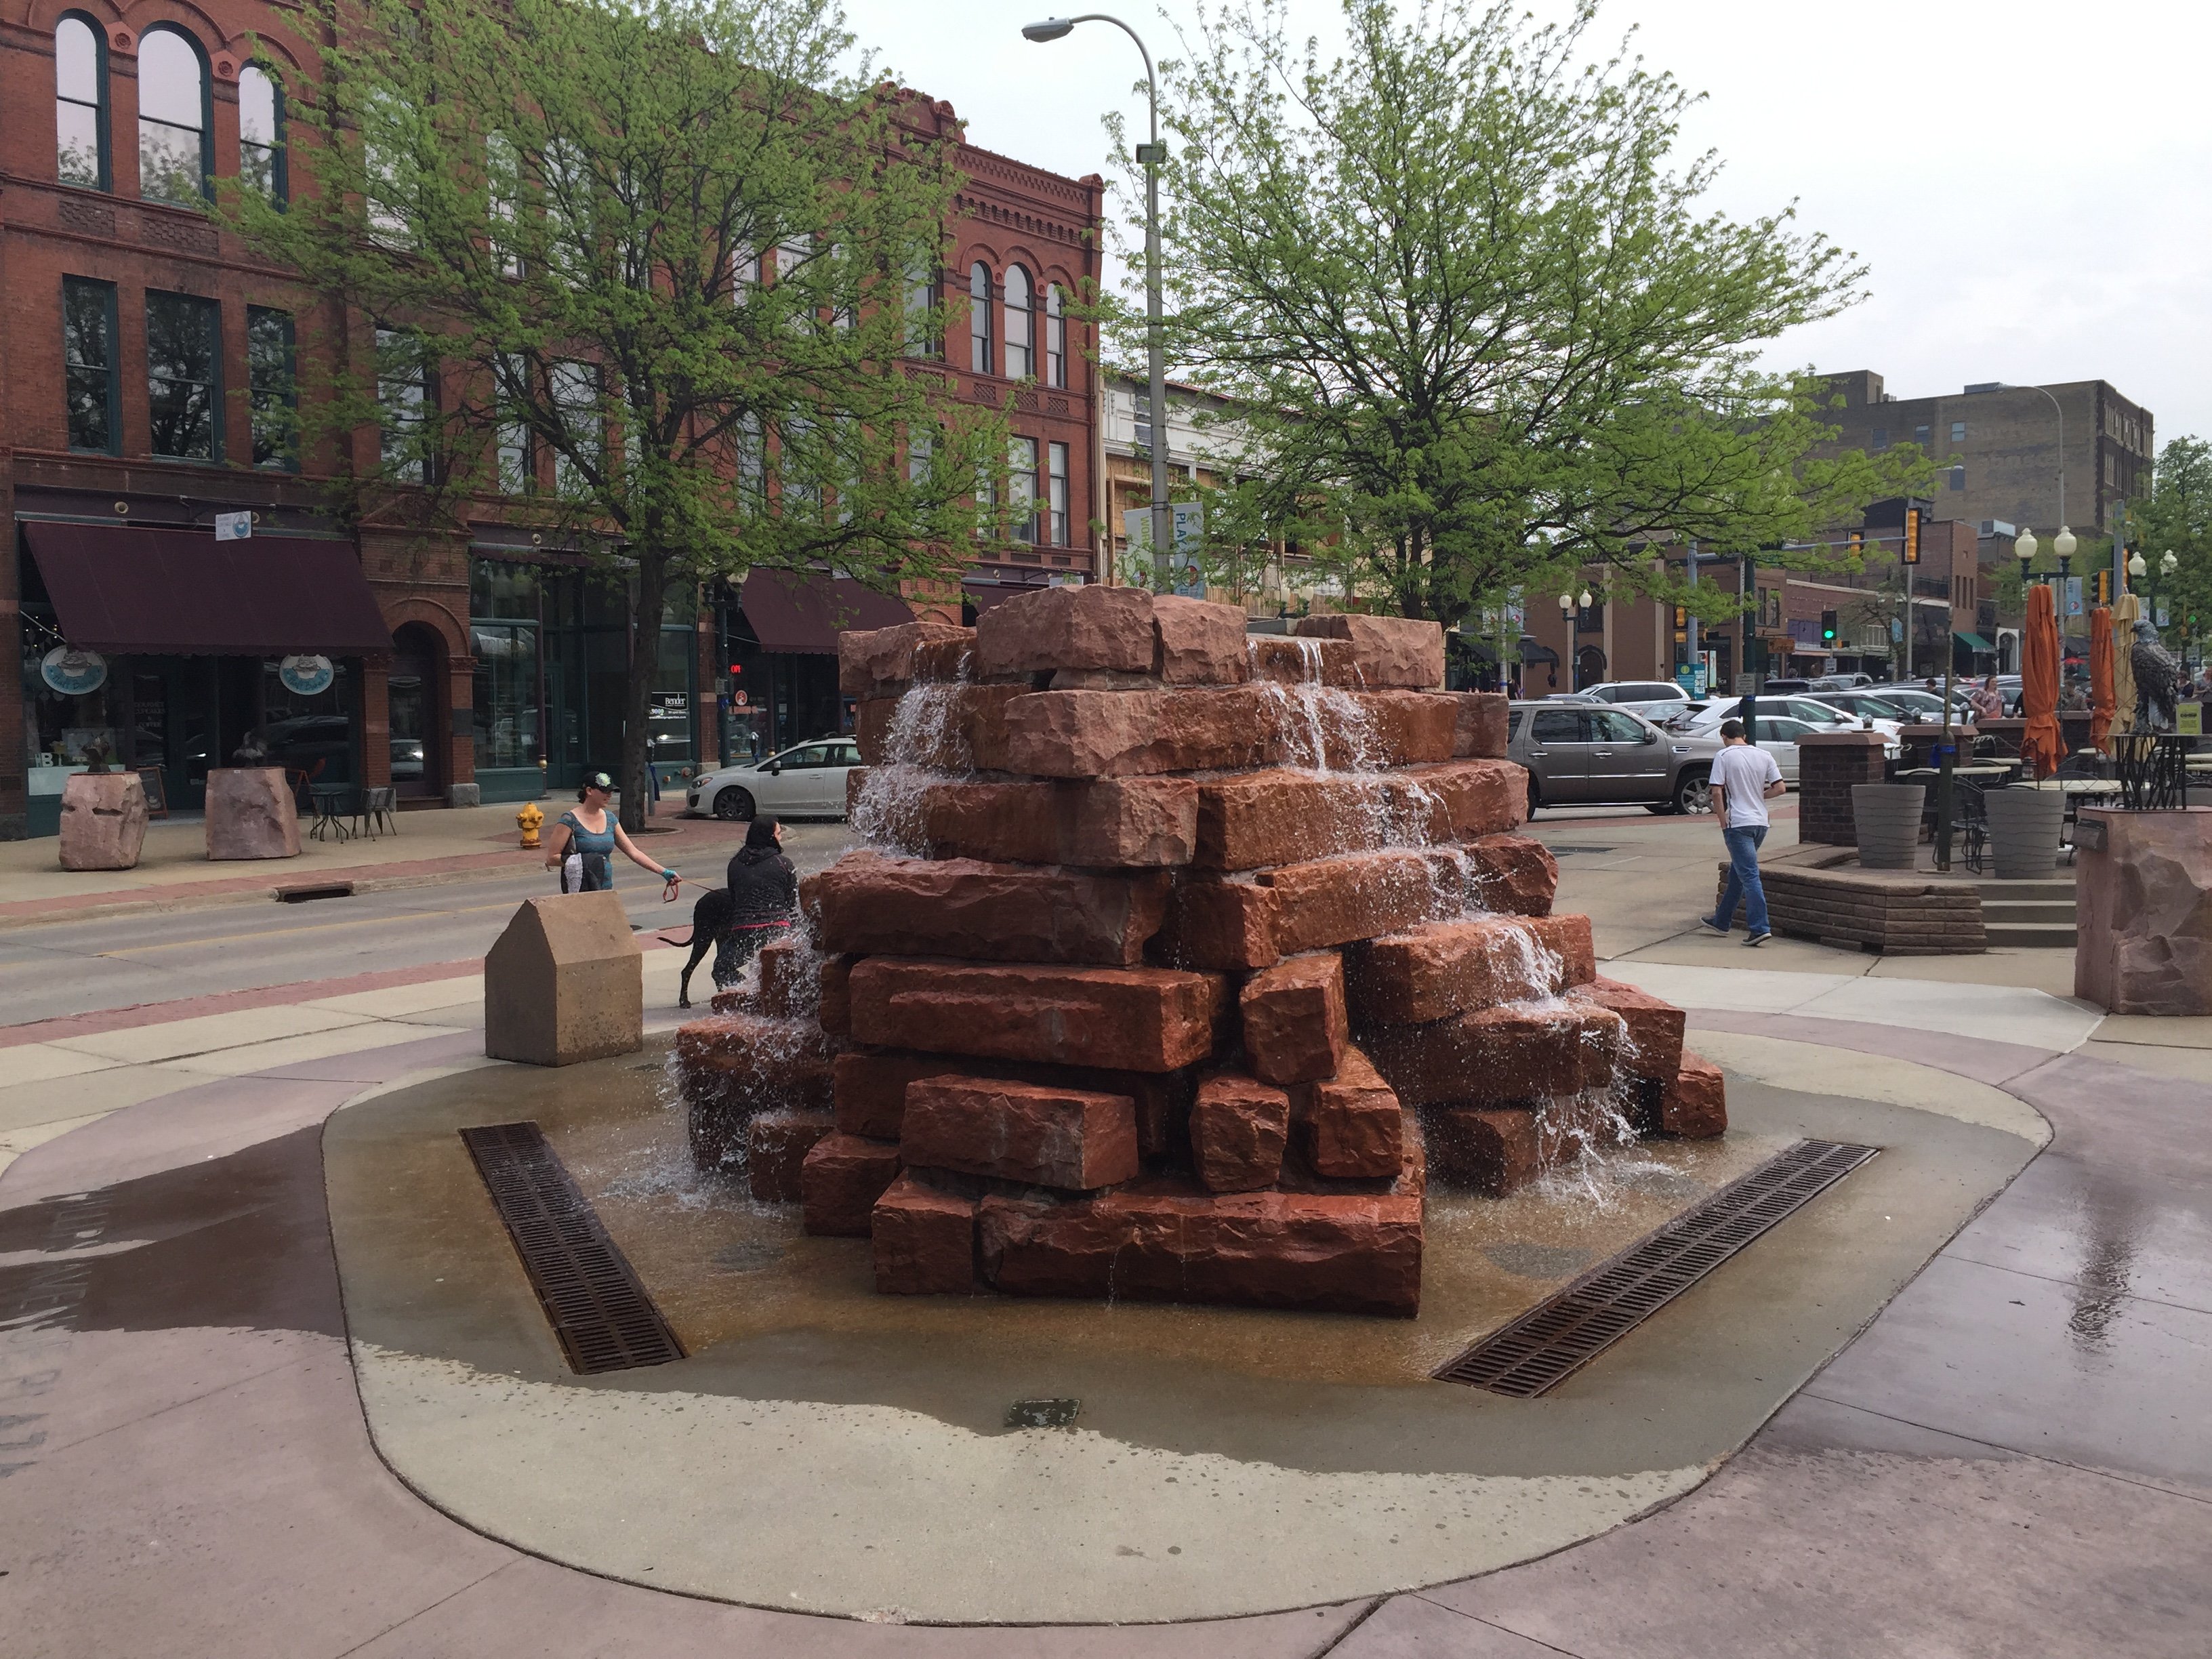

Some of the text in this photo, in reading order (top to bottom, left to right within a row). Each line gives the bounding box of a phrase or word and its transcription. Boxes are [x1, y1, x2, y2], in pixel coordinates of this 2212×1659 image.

[1140, 516, 1151, 543] WOR
[1176, 512, 1187, 544] PLAY
[665, 693, 686, 705] Bender
